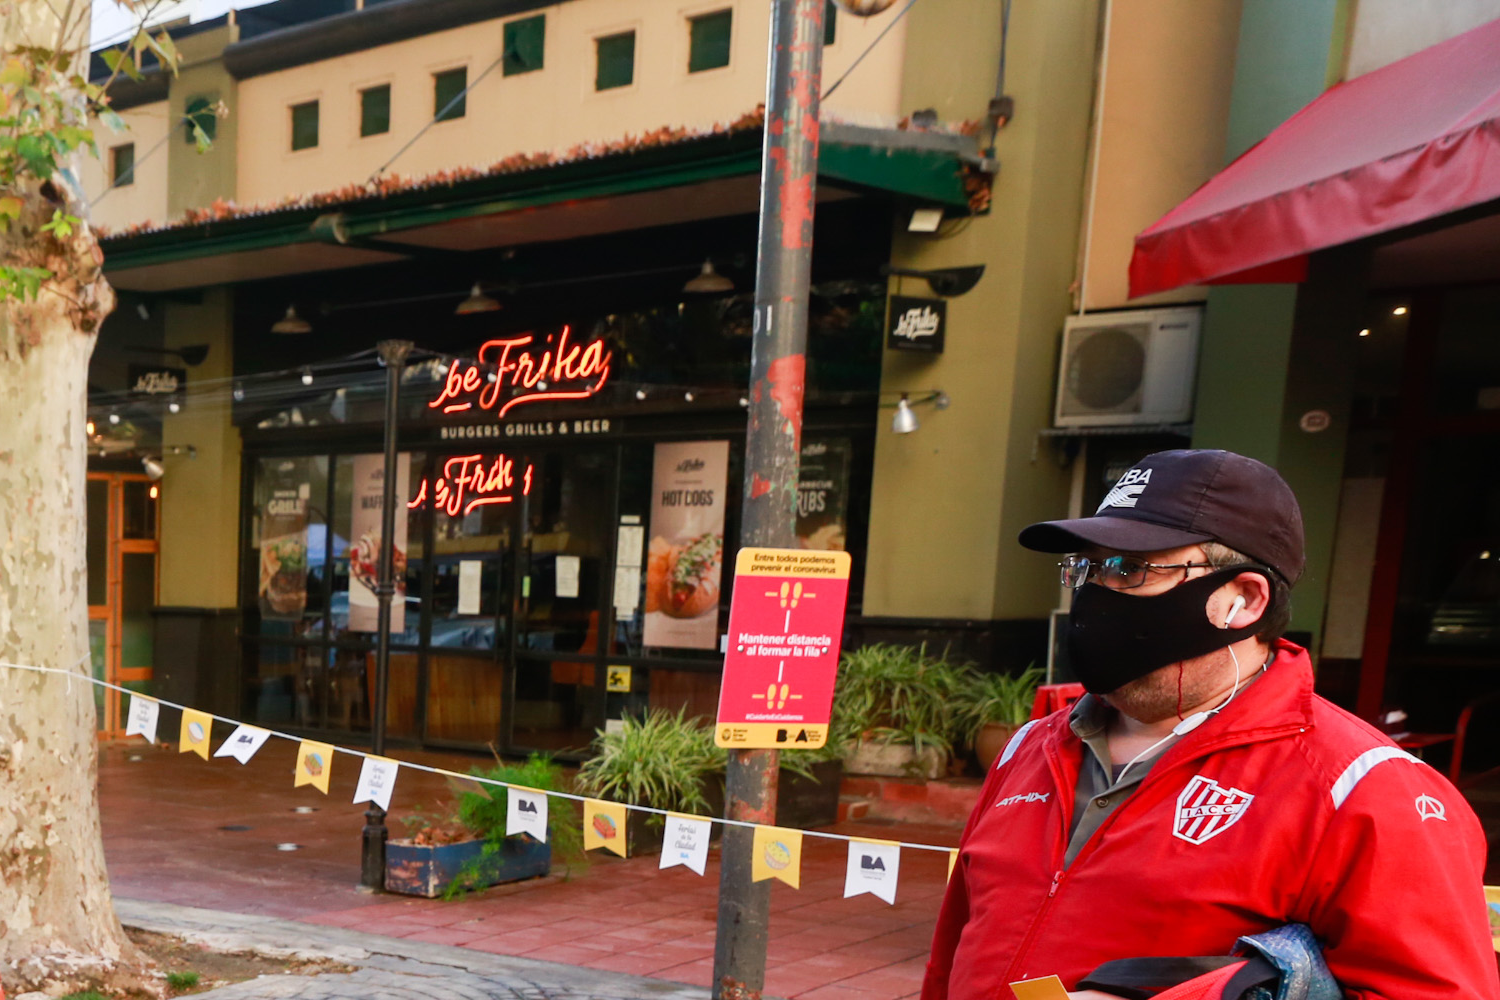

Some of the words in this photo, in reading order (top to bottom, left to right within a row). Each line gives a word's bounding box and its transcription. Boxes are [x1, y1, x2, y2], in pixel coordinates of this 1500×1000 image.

[478, 324, 612, 418] Frika
[441, 424, 500, 439] BURGERS
[505, 422, 553, 436] GRILLS
[558, 421, 568, 434] &
[574, 419, 610, 434] BEER
[661, 490, 682, 507] HOT
[684, 489, 714, 506] DOGS
[754, 554, 775, 562] Entre
[777, 555, 798, 563] todos
[800, 556, 836, 564] podemos
[751, 564, 782, 572] prevenir
[793, 566, 836, 574] coronavirus
[738, 633, 786, 645] Mantener
[787, 634, 831, 646] distancia
[746, 645, 757, 656] al
[757, 645, 791, 657] formar
[793, 646, 803, 657] la
[804, 646, 821, 658] fila
[518, 799, 538, 814] BA
[996, 792, 1049, 808] ATHIX
[861, 854, 886, 871] BA
